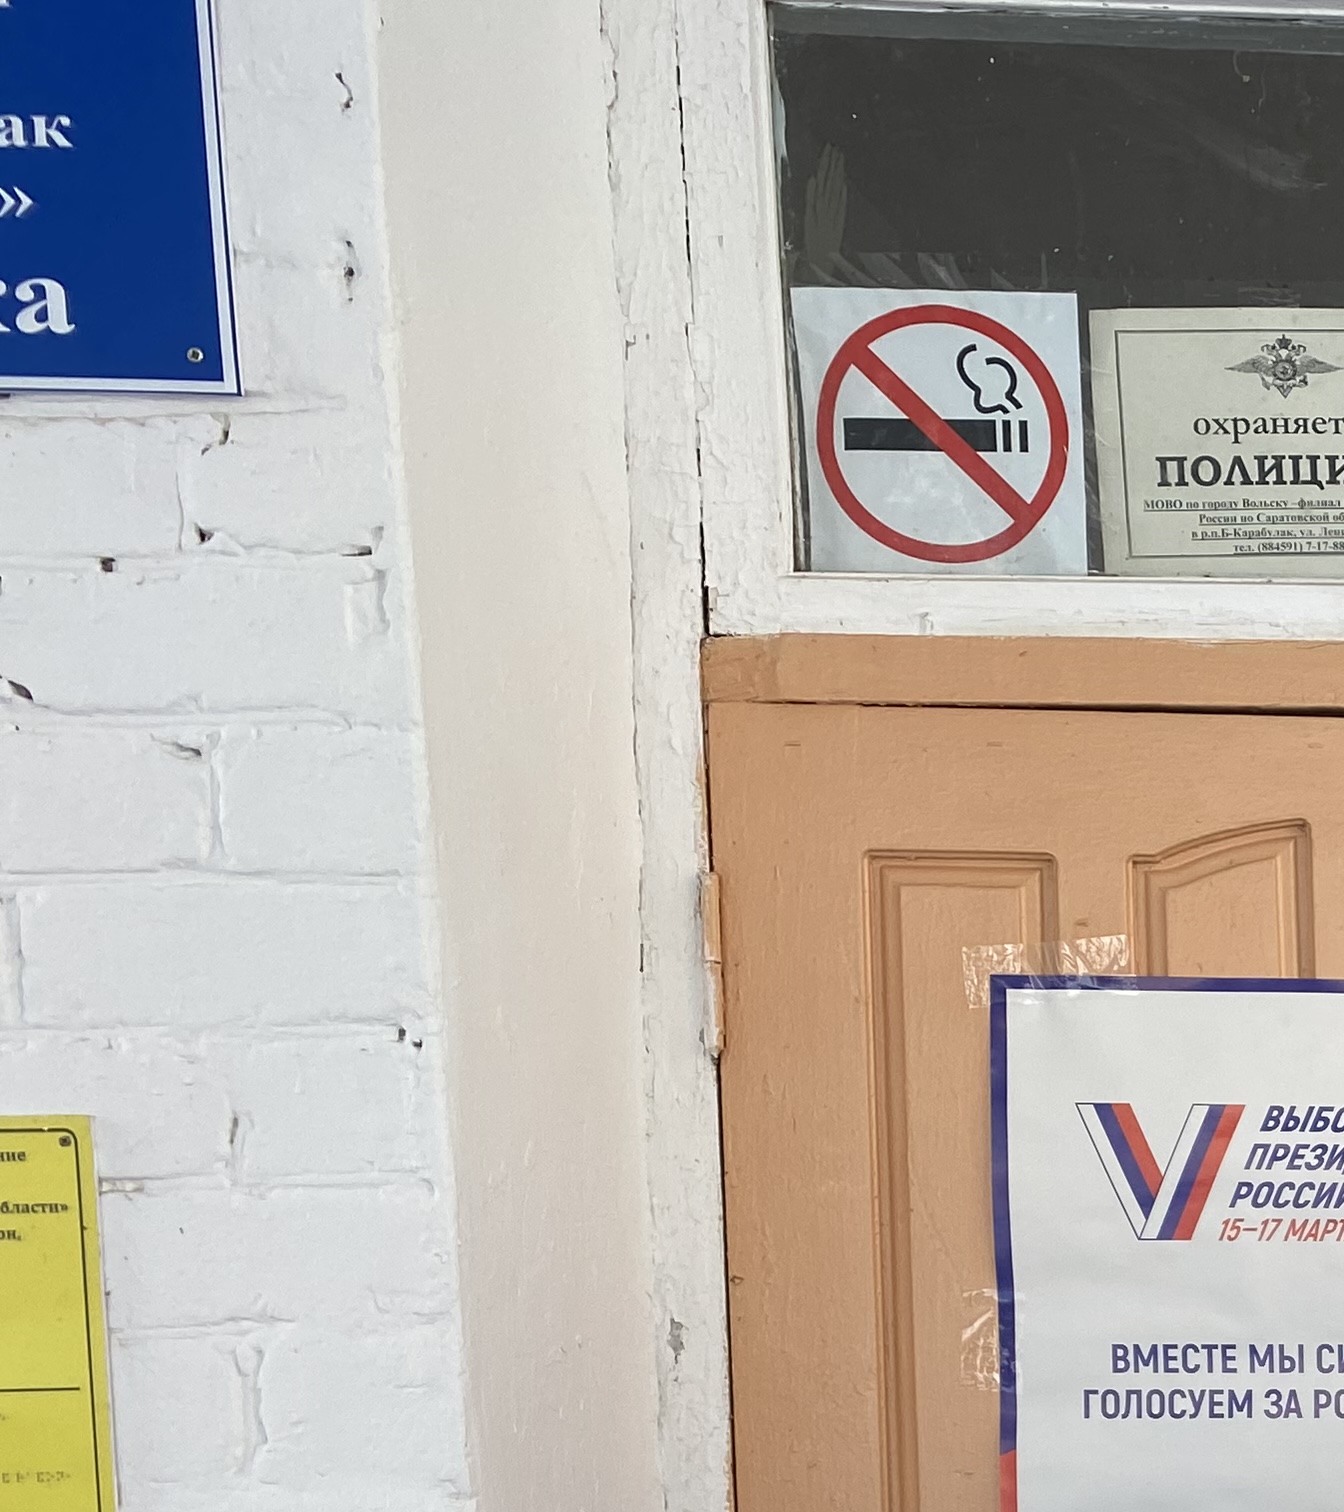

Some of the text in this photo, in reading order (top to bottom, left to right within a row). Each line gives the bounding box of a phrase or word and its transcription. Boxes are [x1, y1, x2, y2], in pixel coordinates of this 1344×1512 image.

[1143, 499, 1183, 511] МОВО
[1186, 501, 1200, 511] по
[1202, 501, 1239, 512] городу
[1242, 498, 1288, 510] Вольску
[1199, 513, 1238, 524] России
[1240, 514, 1254, 523] по
[1256, 512, 1330, 524] Саратовской
[1110, 1343, 1238, 1374] ВМЕСТЕ
[1249, 1343, 1304, 1374] МЫ
[1082, 1388, 1254, 1420] ГОЛОСУЕМ
[1263, 1388, 1303, 1419] ЗА
